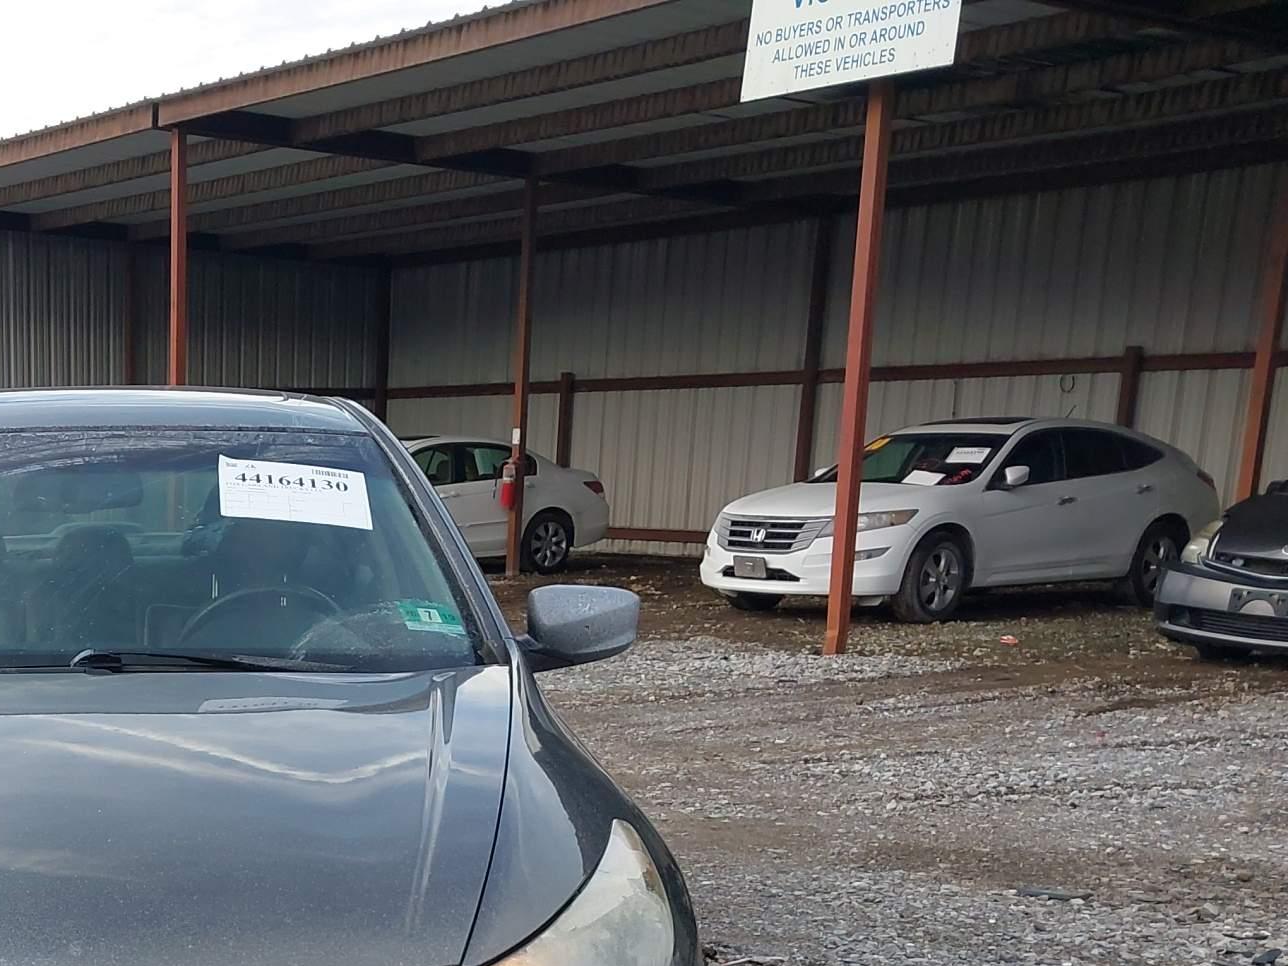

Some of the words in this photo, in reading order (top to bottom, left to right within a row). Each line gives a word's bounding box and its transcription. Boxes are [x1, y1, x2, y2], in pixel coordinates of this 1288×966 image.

[755, 30, 772, 47] NO
[775, 19, 823, 43] BUYERS
[825, 15, 843, 32] OR
[847, 0, 950, 28] TRANSPORTERS
[772, 38, 831, 64] ALLOWED
[833, 35, 846, 52] IN
[849, 31, 867, 49] OR
[869, 20, 925, 45] AROUND
[794, 59, 832, 80] THESE
[835, 47, 896, 72] VEHICLES
[234, 472, 349, 493] 44164130
